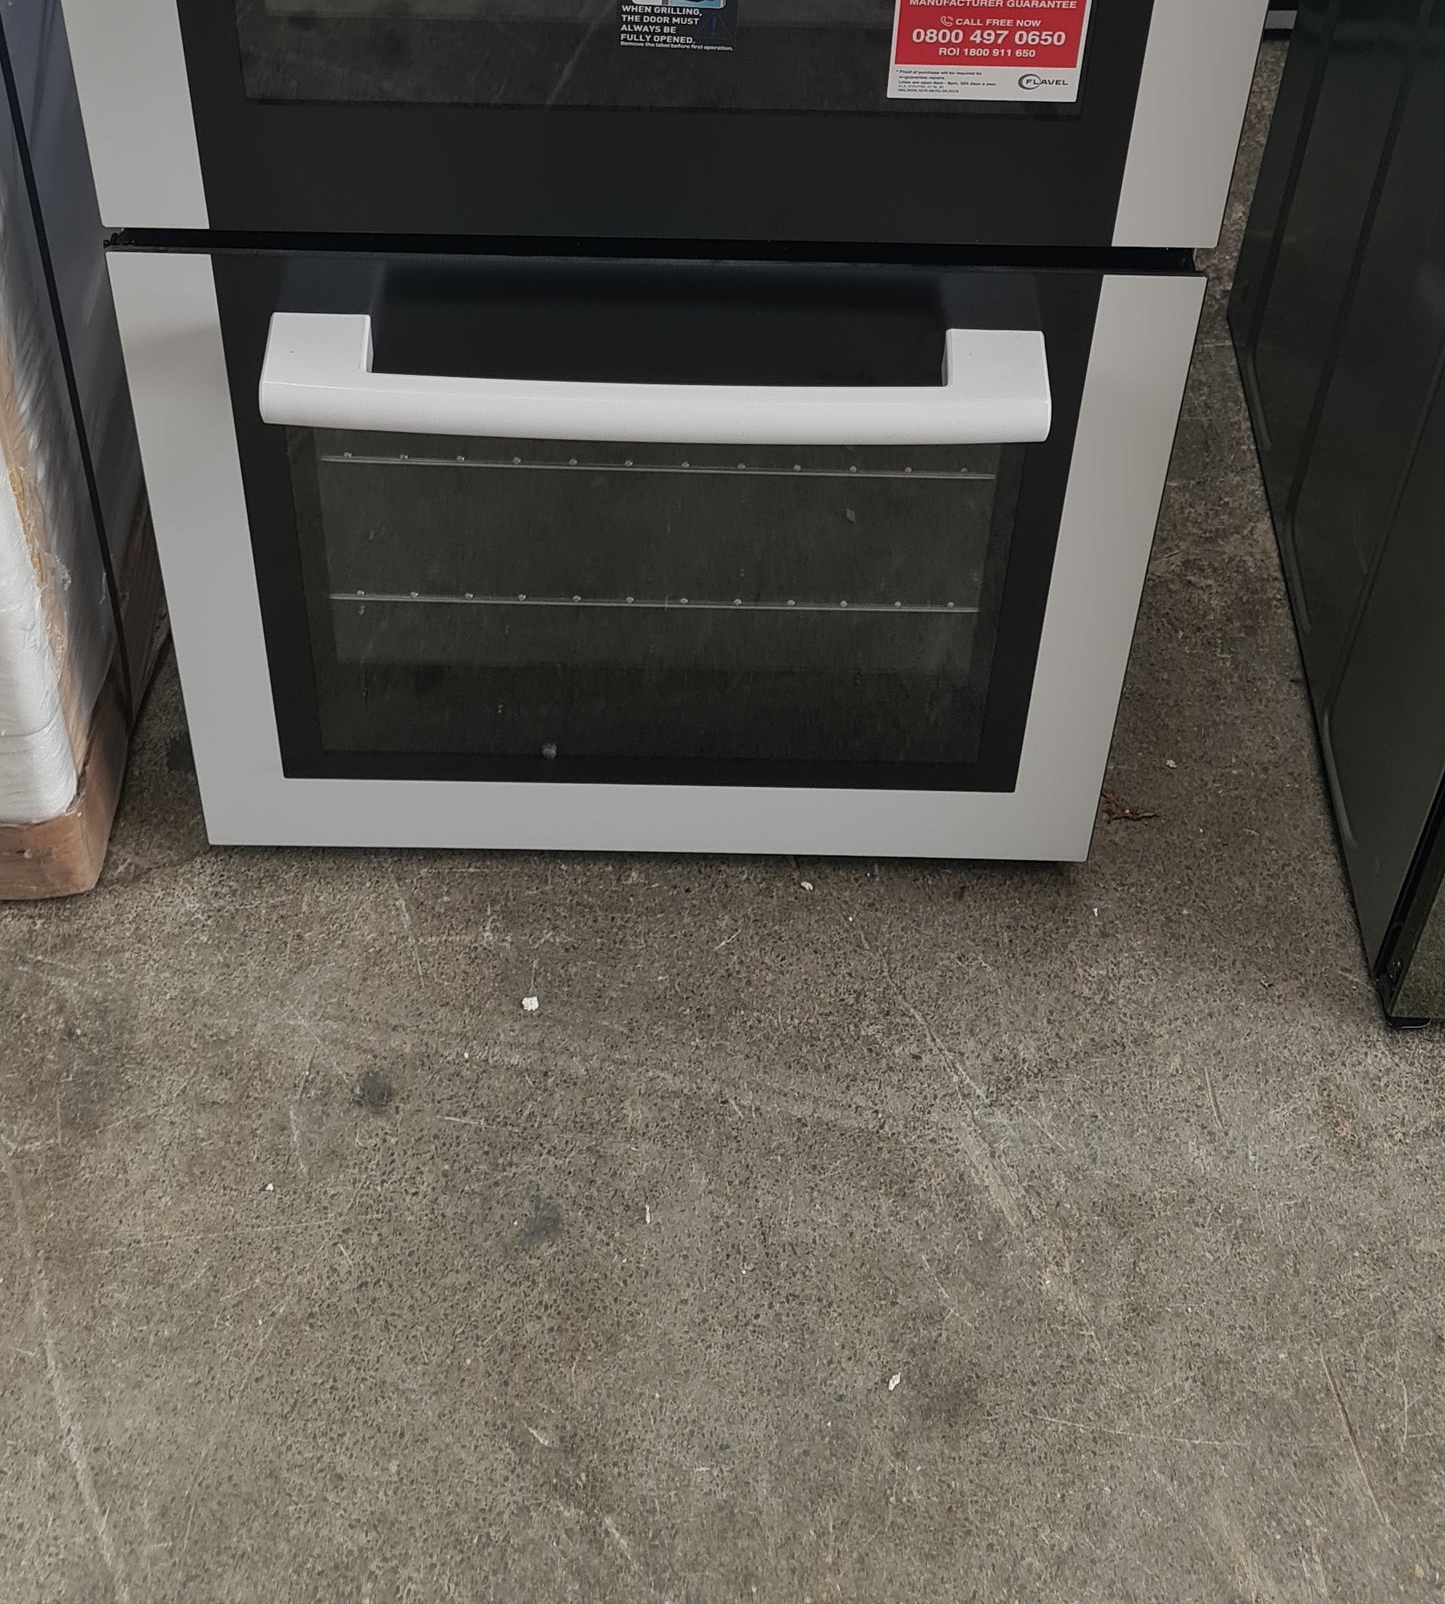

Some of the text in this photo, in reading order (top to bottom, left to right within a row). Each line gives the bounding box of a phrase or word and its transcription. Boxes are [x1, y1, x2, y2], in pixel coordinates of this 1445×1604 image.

[1007, 0, 1077, 9] GUARANTEE
[621, 5, 703, 16] WHEN GRILLING,
[621, 14, 700, 25] THE DOOR MUST
[955, 18, 1041, 28] CALL FREE NOW
[620, 24, 677, 34] ALWAYS BE
[620, 34, 696, 44] FULLY OPENED.
[912, 28, 1066, 46] 0800 497 0650
[938, 47, 1036, 58] ROI 1800 911 650
